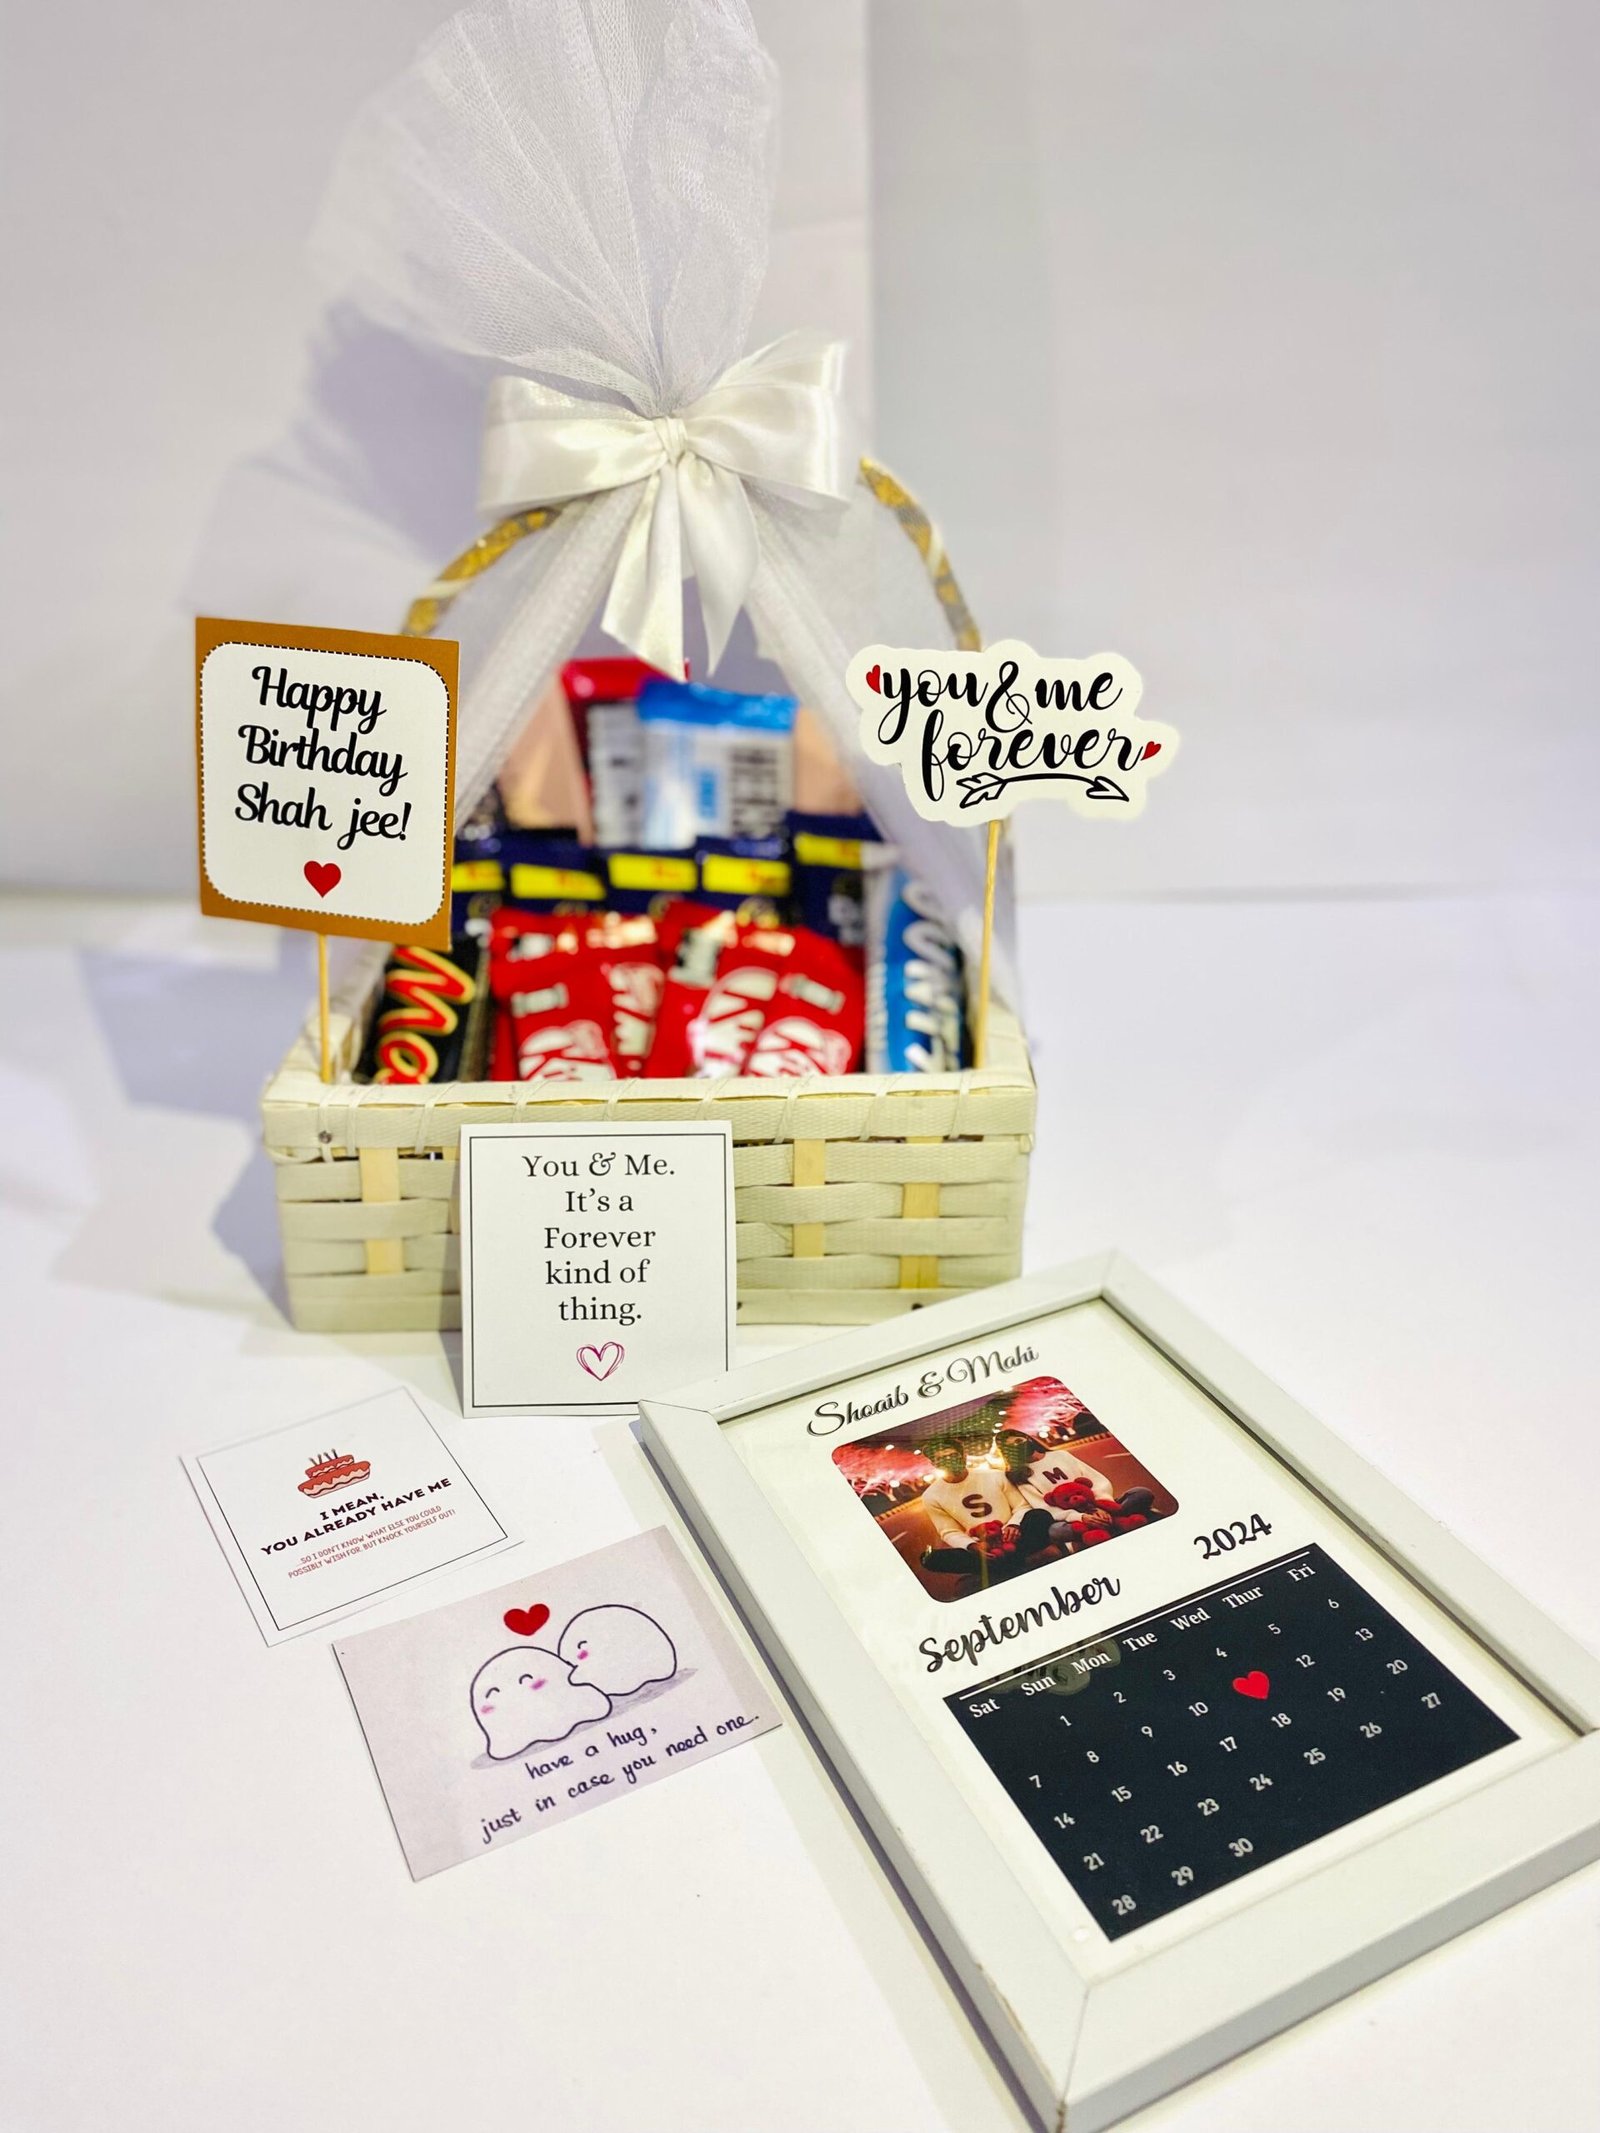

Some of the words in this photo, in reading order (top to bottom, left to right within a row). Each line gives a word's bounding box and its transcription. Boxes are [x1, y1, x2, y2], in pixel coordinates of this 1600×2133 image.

[252, 666, 387, 734] Happy
[238, 725, 408, 797] Birthday
[922, 709, 1144, 801] forever
[235, 782, 332, 830] Shah
[337, 798, 412, 850] jee!
[522, 1155, 580, 1177] You
[588, 1152, 616, 1176] &
[625, 1154, 675, 1176] Me.
[619, 1194, 634, 1212] a
[544, 1227, 656, 1249] Forever
[545, 1259, 611, 1284] kind
[619, 1258, 651, 1283] of
[559, 1296, 642, 1325] thing.
[806, 1386, 909, 1437] Shoaib
[917, 1371, 944, 1400] &
[945, 1345, 1039, 1386] Mahi
[962, 1494, 992, 1518] S
[1042, 1467, 1068, 1484] M
[261, 1536, 299, 1555] YOU
[303, 1507, 377, 1542] ALREADY
[381, 1489, 425, 1511] HAVE
[427, 1478, 452, 1494] ME
[288, 1561, 323, 1578] POSSIBLY
[324, 1552, 347, 1565] WISH
[363, 1539, 378, 1552] BUT
[378, 1531, 404, 1545] KNOCK
[404, 1516, 438, 1533] YOURSELF
[320, 1511, 330, 1521] I
[341, 1535, 365, 1550] KNOW
[366, 1527, 387, 1542] WHAT
[387, 1520, 404, 1534] ELSE
[404, 1514, 420, 1527] YOU
[419, 1505, 442, 1520] COULD
[918, 1572, 1121, 1673] September
[1193, 1512, 1273, 1560] 2024
[968, 1697, 1000, 1720] Sat
[1020, 1674, 1057, 1697] Sun
[1071, 1650, 1112, 1677] Mon
[1122, 1630, 1158, 1653] Tue
[1169, 1608, 1212, 1632] Wed
[1222, 1585, 1264, 1610] Thur
[1287, 1563, 1316, 1583] Fri
[1060, 1715, 1072, 1727] 1
[1113, 1691, 1127, 1705] 2
[1163, 1669, 1176, 1682] 3
[1215, 1647, 1228, 1659] 4
[1268, 1624, 1281, 1636] 5
[1327, 1598, 1340, 1610] 6
[1029, 1774, 1042, 1789] 7
[1086, 1750, 1100, 1764] 8
[1141, 1725, 1154, 1739] 9
[1188, 1702, 1209, 1718] 10
[1295, 1654, 1316, 1669] 12
[1354, 1628, 1374, 1641] 13
[525, 1753, 574, 1779] have
[584, 1745, 600, 1758] a
[607, 1726, 657, 1748] hug,
[1054, 1812, 1076, 1829] 14
[1111, 1786, 1132, 1803] 15
[1167, 1761, 1188, 1777] 16
[1218, 1736, 1239, 1752] 17
[1270, 1712, 1292, 1728] 18
[1326, 1687, 1347, 1703] 19
[1386, 1659, 1409, 1675] 20
[481, 1807, 522, 1844] just
[535, 1795, 556, 1812] in
[567, 1772, 615, 1798] case
[622, 1755, 657, 1784] you
[665, 1726, 708, 1757] need
[1083, 1852, 1105, 1871] 21
[1140, 1824, 1164, 1844] 22
[1197, 1798, 1220, 1816] 23
[1249, 1773, 1273, 1791] 24
[1303, 1748, 1326, 1766] 25
[1359, 1722, 1383, 1739] 26
[1420, 1692, 1442, 1710] 27
[1111, 1894, 1137, 1916] 28
[1171, 1866, 1195, 1886] 29
[1228, 1837, 1254, 1858] 30
